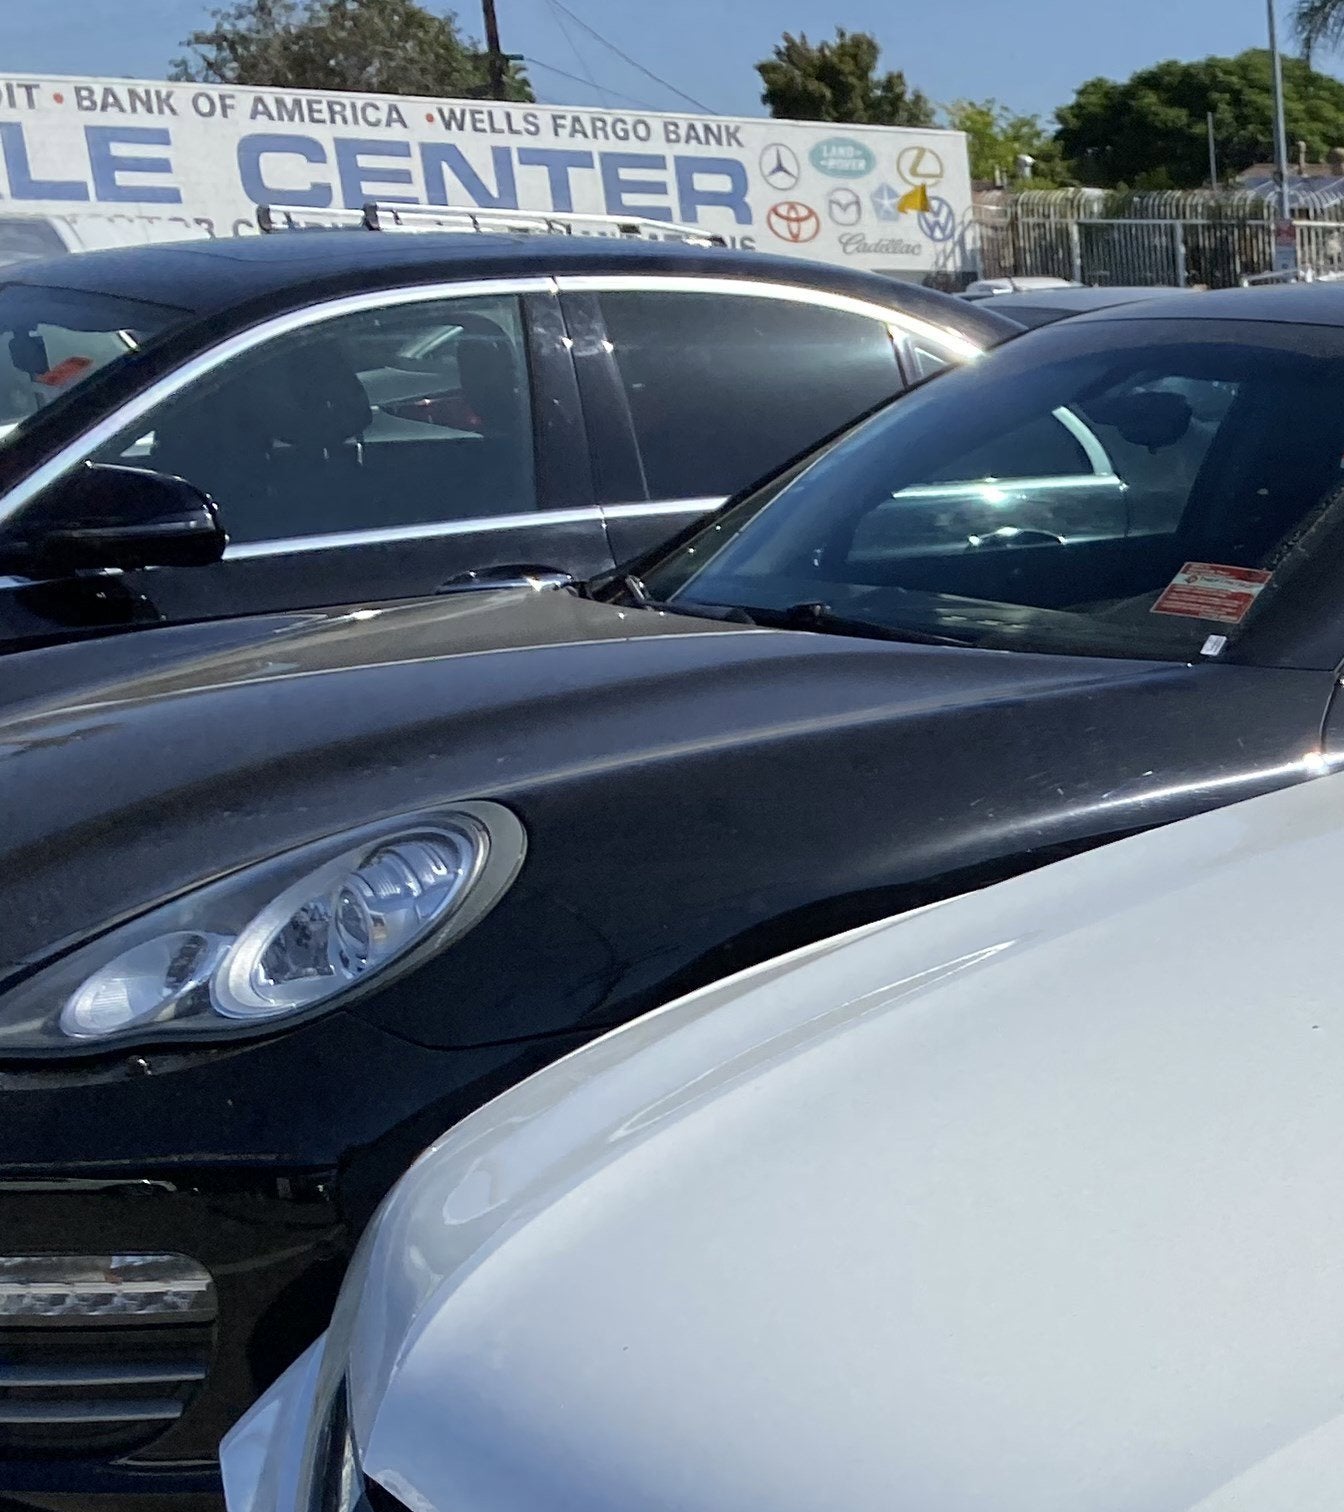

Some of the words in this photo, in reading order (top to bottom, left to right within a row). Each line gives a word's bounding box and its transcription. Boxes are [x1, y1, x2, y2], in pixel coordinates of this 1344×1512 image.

[0, 82, 40, 109] IT
[75, 85, 178, 116] BANK
[192, 91, 236, 119] OF
[250, 95, 408, 128] AMERICA
[436, 107, 540, 136] WELLS
[552, 113, 651, 142] FARGO
[663, 121, 744, 148] BANK
[0, 121, 182, 204] LE
[237, 133, 753, 225] CENTER
[822, 145, 855, 158] LAND
[838, 232, 922, 256] Cadillac
